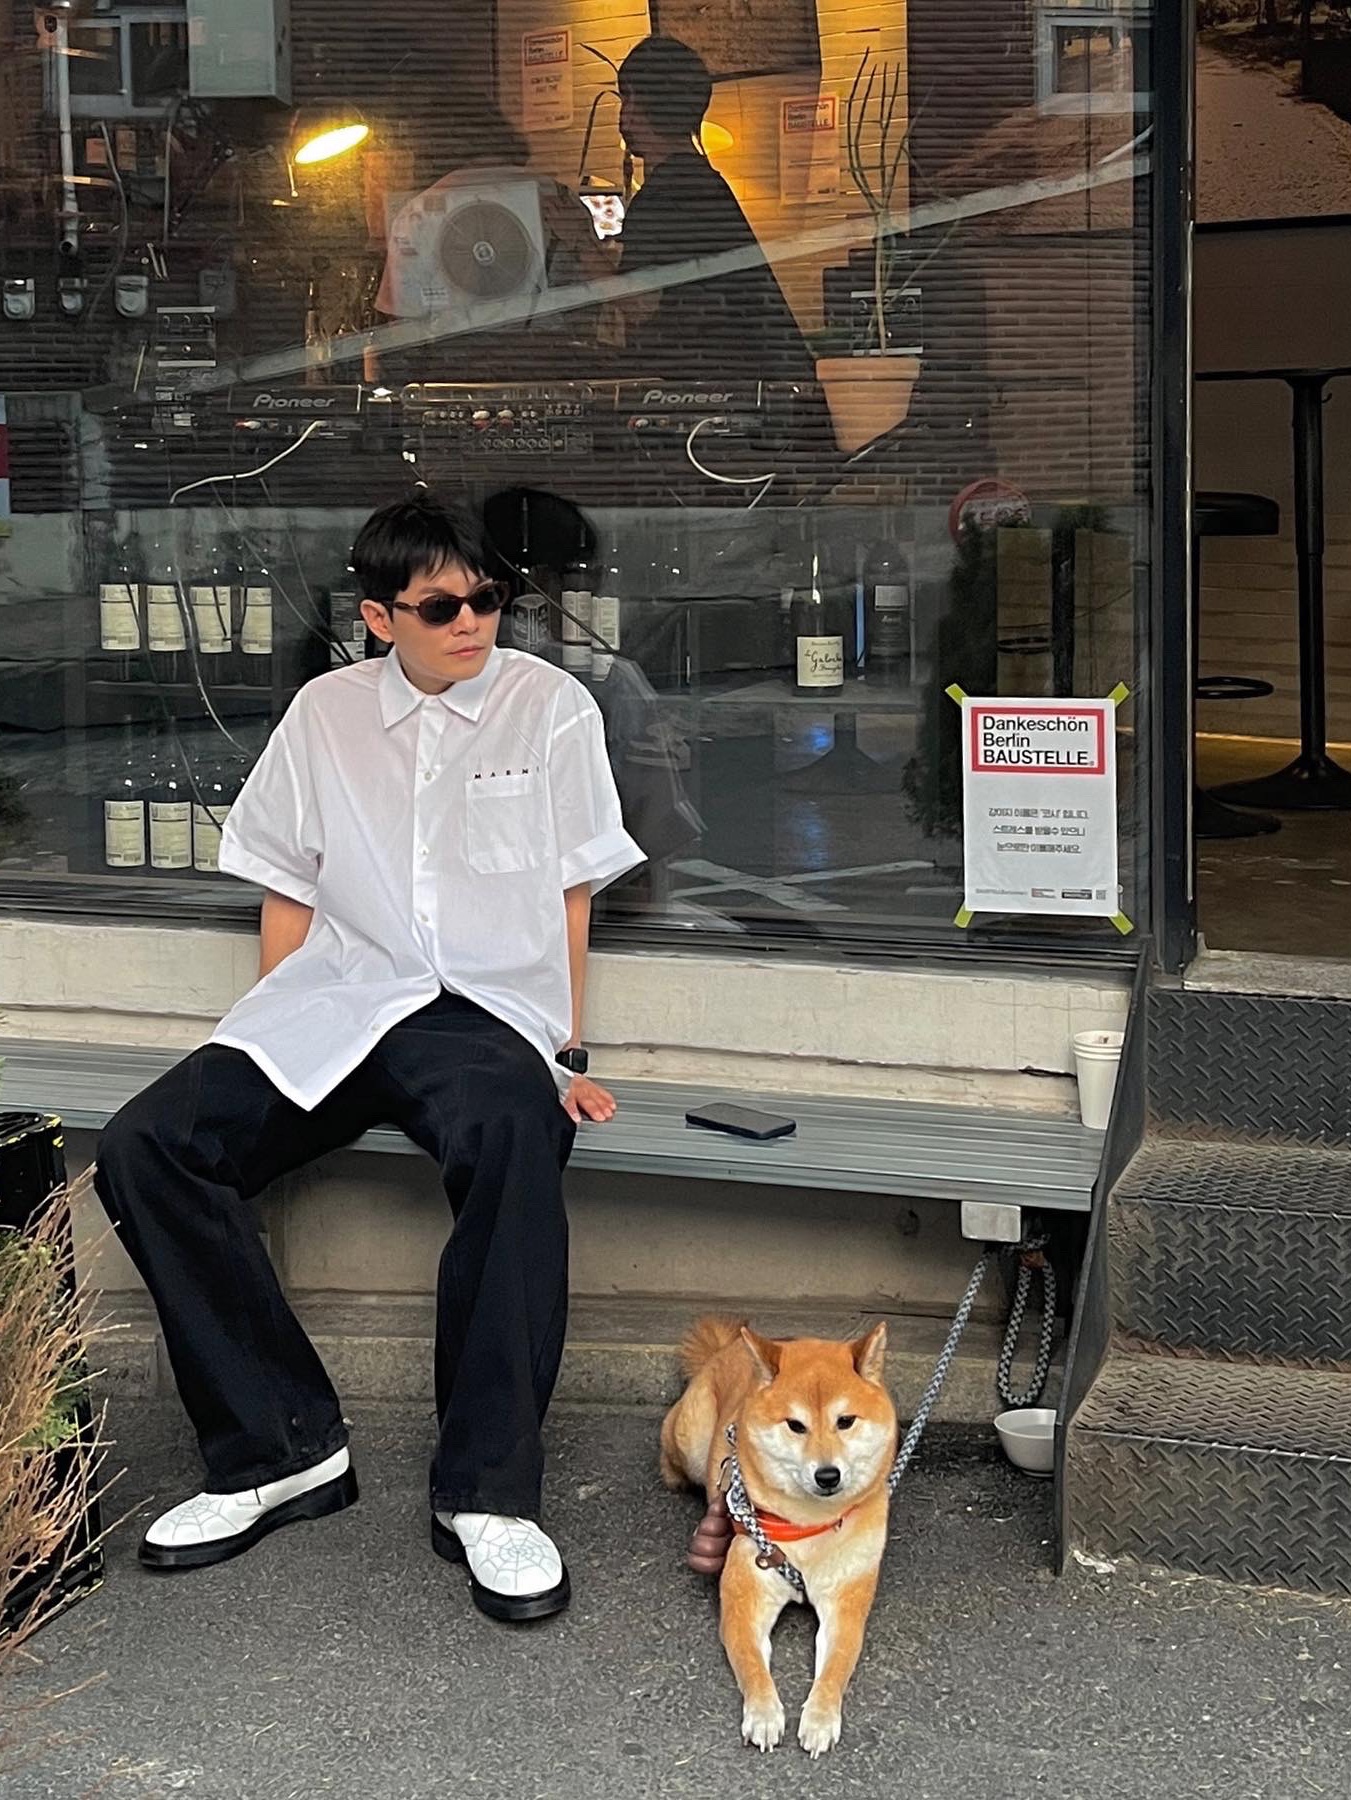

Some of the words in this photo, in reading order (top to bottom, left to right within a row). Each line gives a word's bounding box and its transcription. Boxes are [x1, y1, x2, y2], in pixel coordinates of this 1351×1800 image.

[253, 394, 335, 408] Pioneer
[643, 390, 733, 404] Pioneer
[983, 716, 1088, 731] Dankeschön
[983, 732, 1030, 747] Berlin
[983, 749, 1089, 765] BAUSTELLE
[475, 766, 539, 779] MARNI
